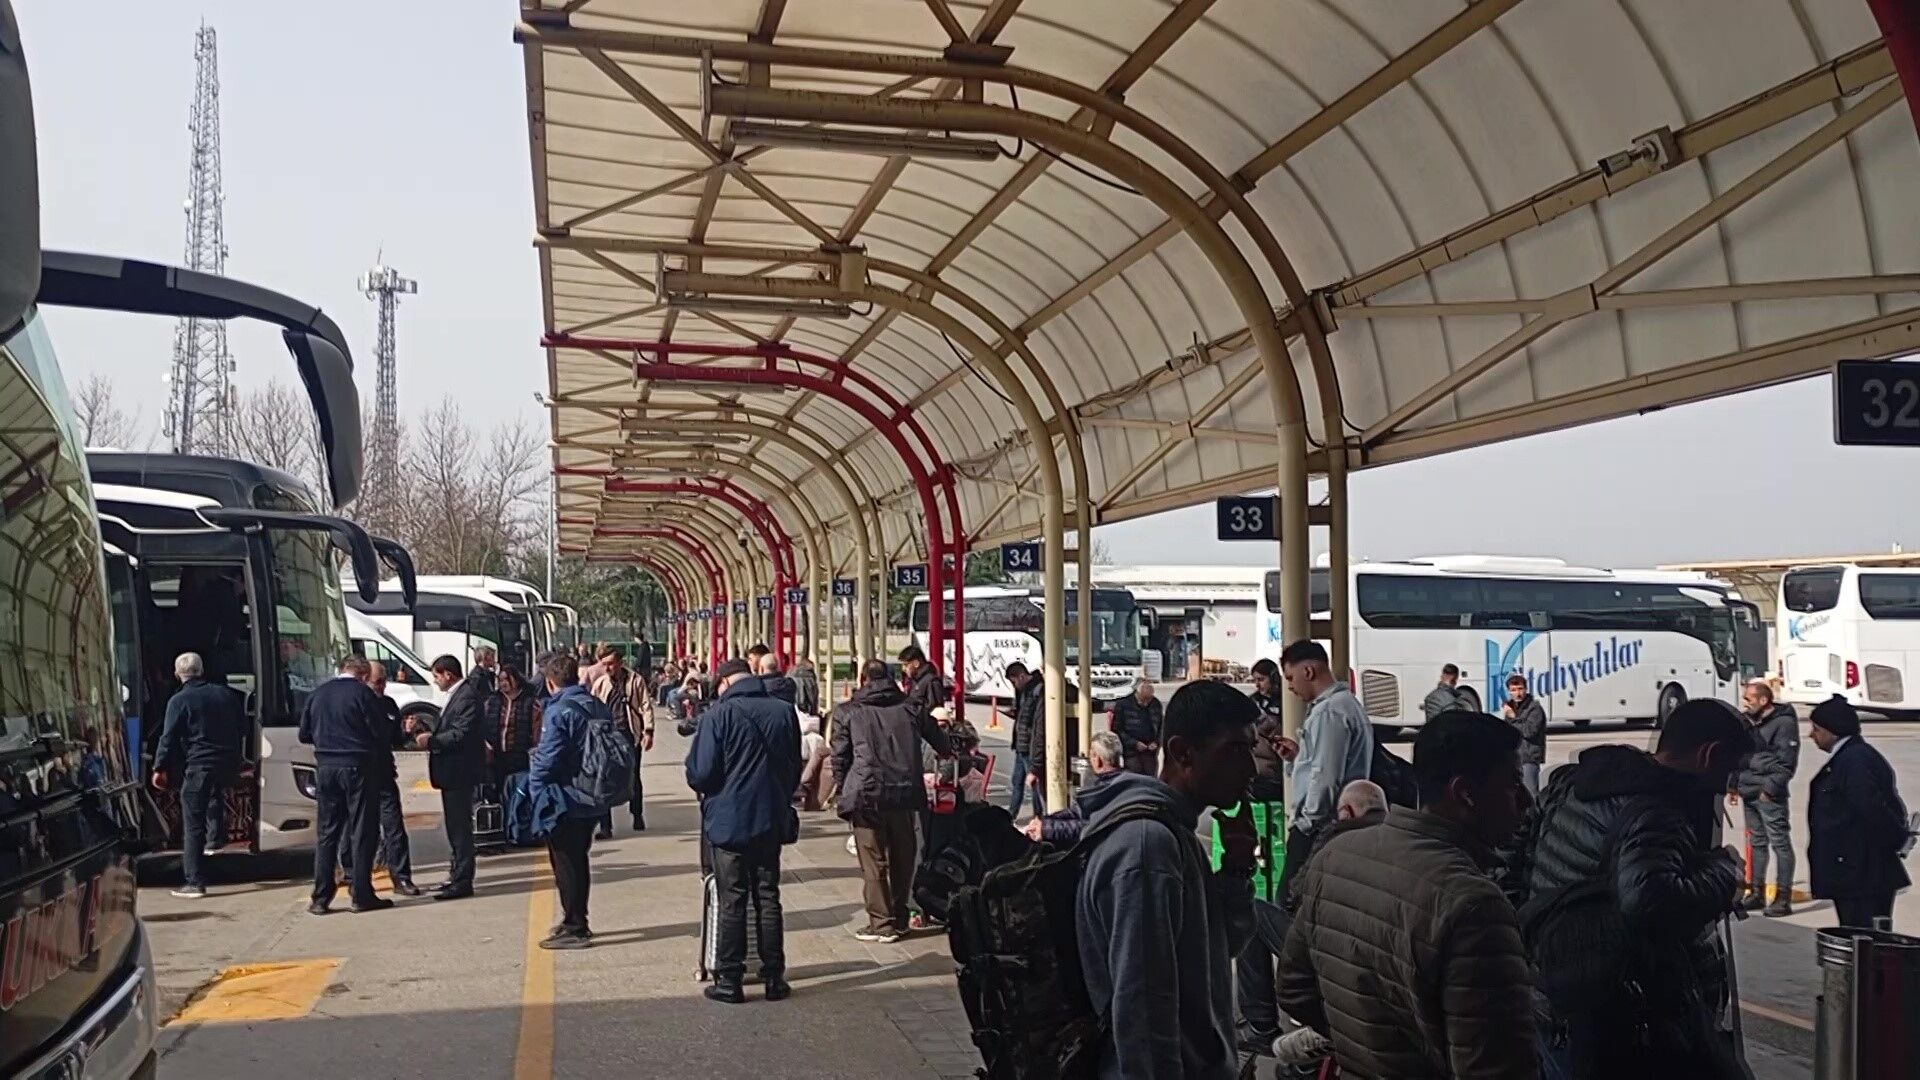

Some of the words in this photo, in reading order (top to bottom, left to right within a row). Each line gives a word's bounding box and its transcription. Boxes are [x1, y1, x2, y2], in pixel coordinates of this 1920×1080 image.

[1862, 379, 1920, 428] 32
[1230, 506, 1263, 532] 33
[1009, 549, 1033, 567] 34
[902, 569, 921, 585] 35
[791, 592, 804, 602] 37
[836, 582, 851, 594] 36
[1486, 632, 1643, 713] Ktahyalılar
